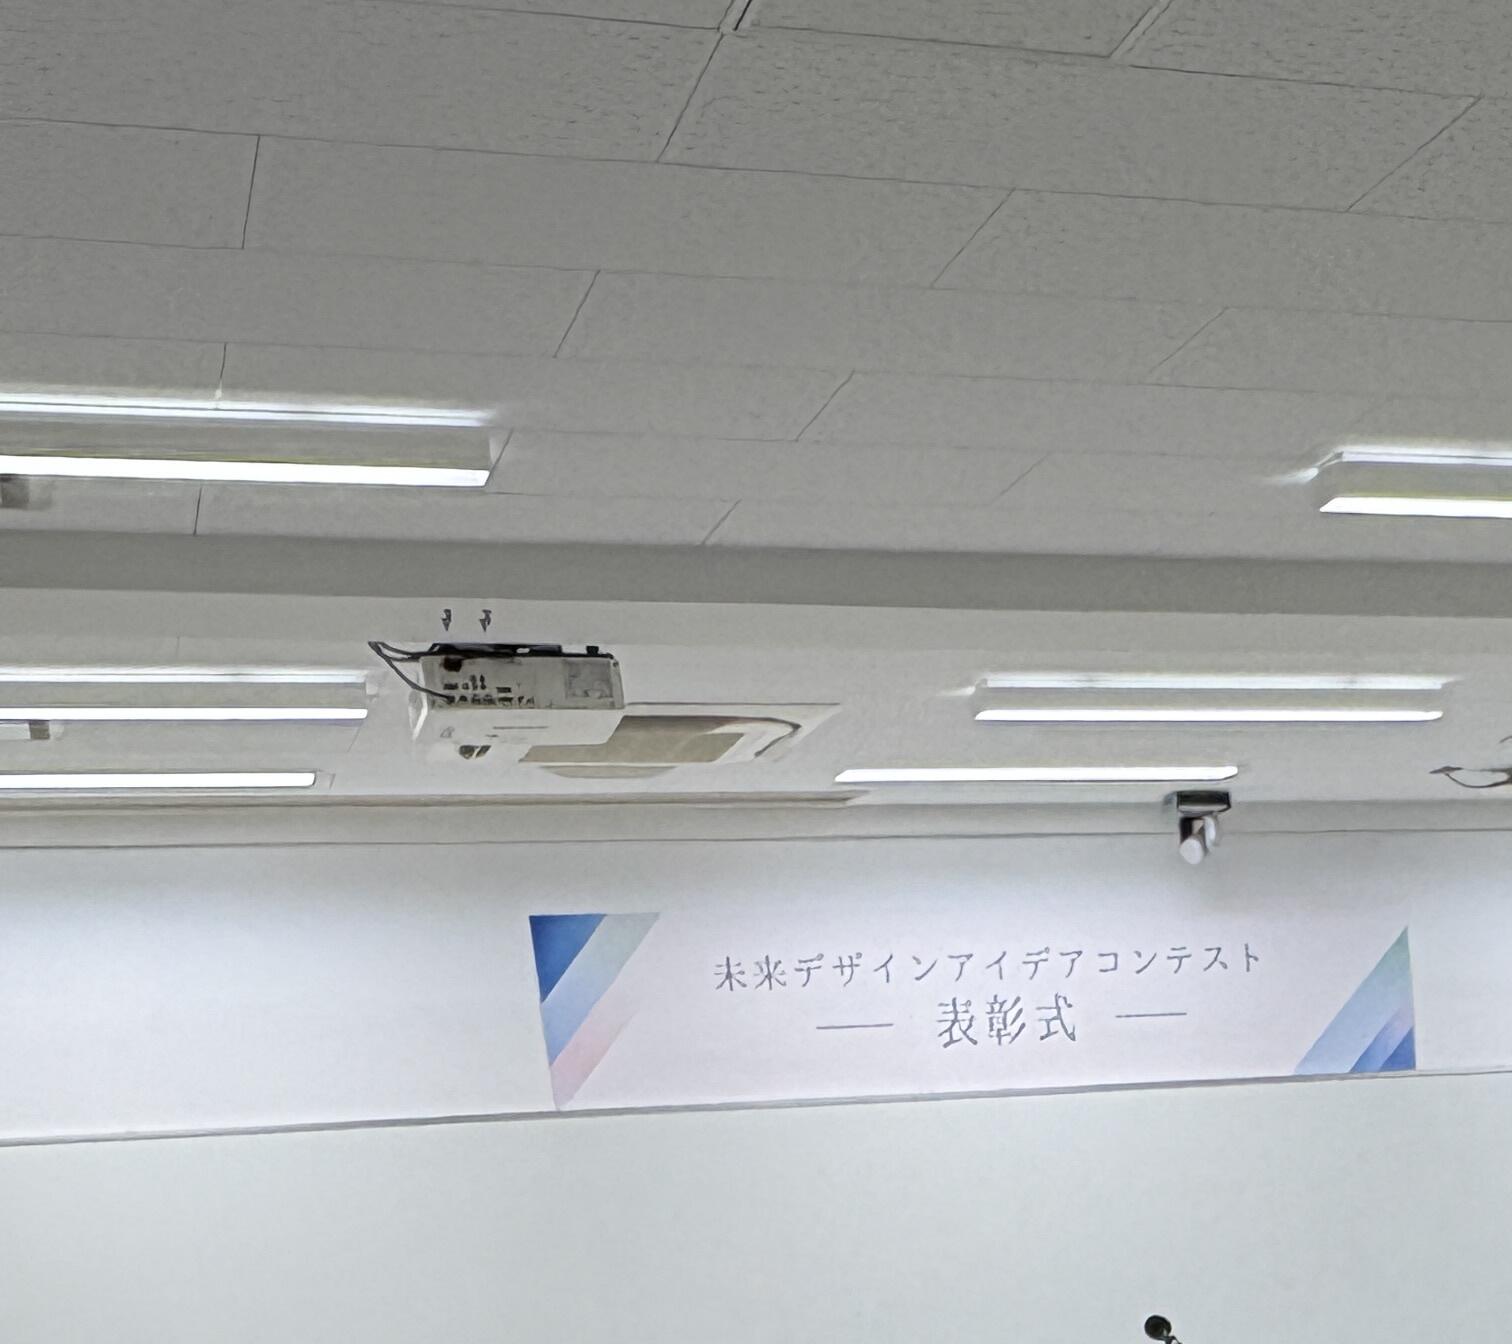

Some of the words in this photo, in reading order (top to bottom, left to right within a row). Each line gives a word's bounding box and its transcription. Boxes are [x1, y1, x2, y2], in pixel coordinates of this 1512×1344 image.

[713, 943, 1260, 992] 未来デザインアイデアコンテスト
[936, 992, 1077, 1048] 表彰式
